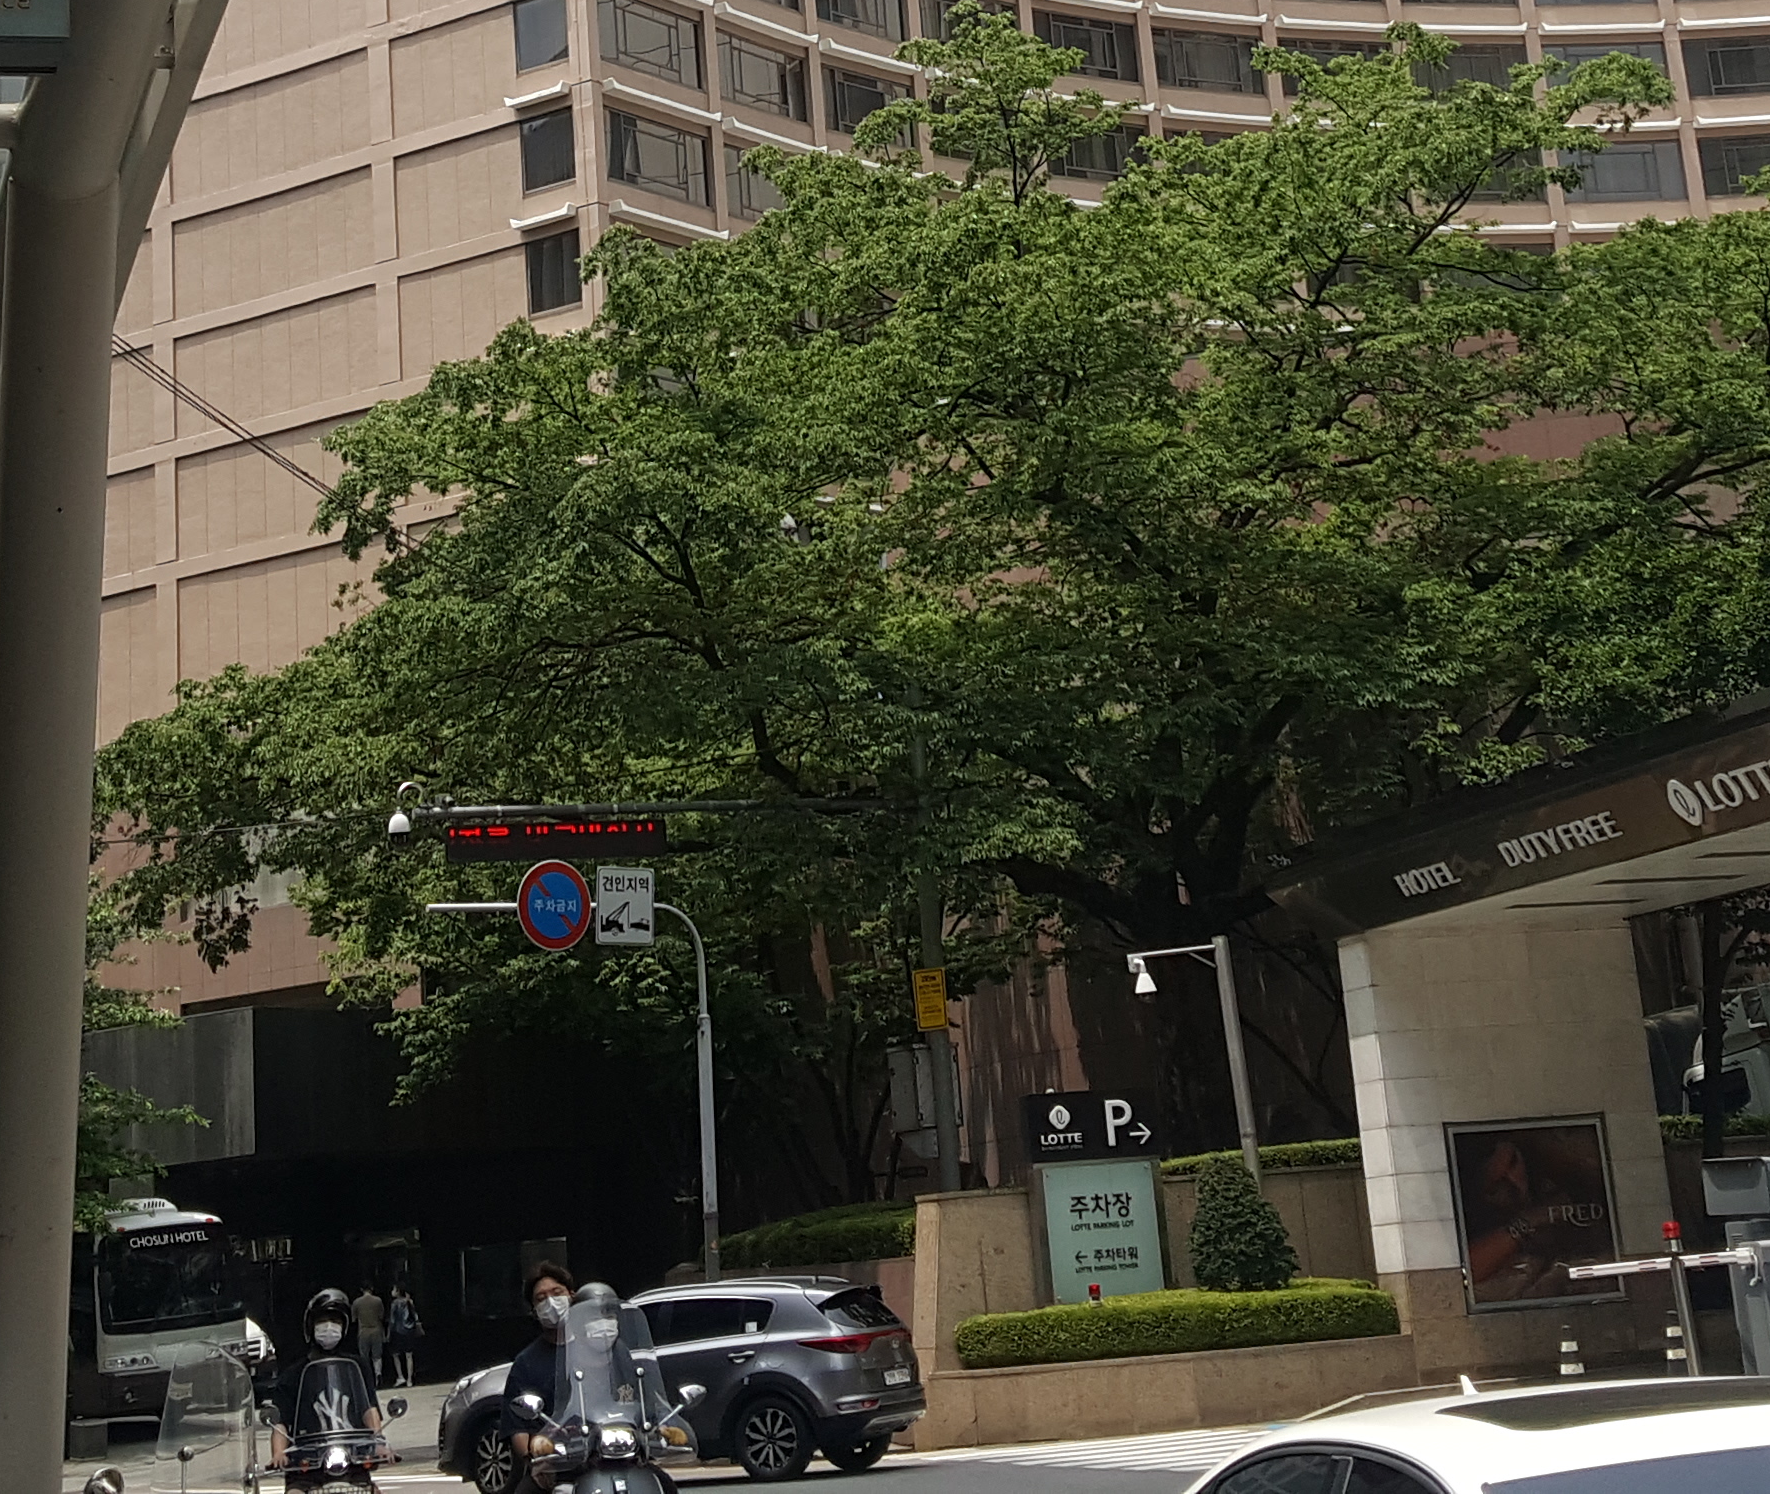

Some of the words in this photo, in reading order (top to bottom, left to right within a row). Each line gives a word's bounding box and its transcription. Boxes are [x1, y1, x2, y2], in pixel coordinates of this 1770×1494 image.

[601, 874, 650, 893] 견인지역
[1394, 860, 1461, 899] HOTEL
[533, 898, 578, 914] 주차금지
[1103, 1099, 1133, 1147] P
[1040, 1132, 1083, 1146] LOTTE
[1069, 1192, 1133, 1220] 주차장
[1548, 1203, 1604, 1227] FRED
[130, 1233, 174, 1249] CHOSUN
[175, 1230, 209, 1244] HOTEL
[1093, 1245, 1139, 1263] 주차타워
